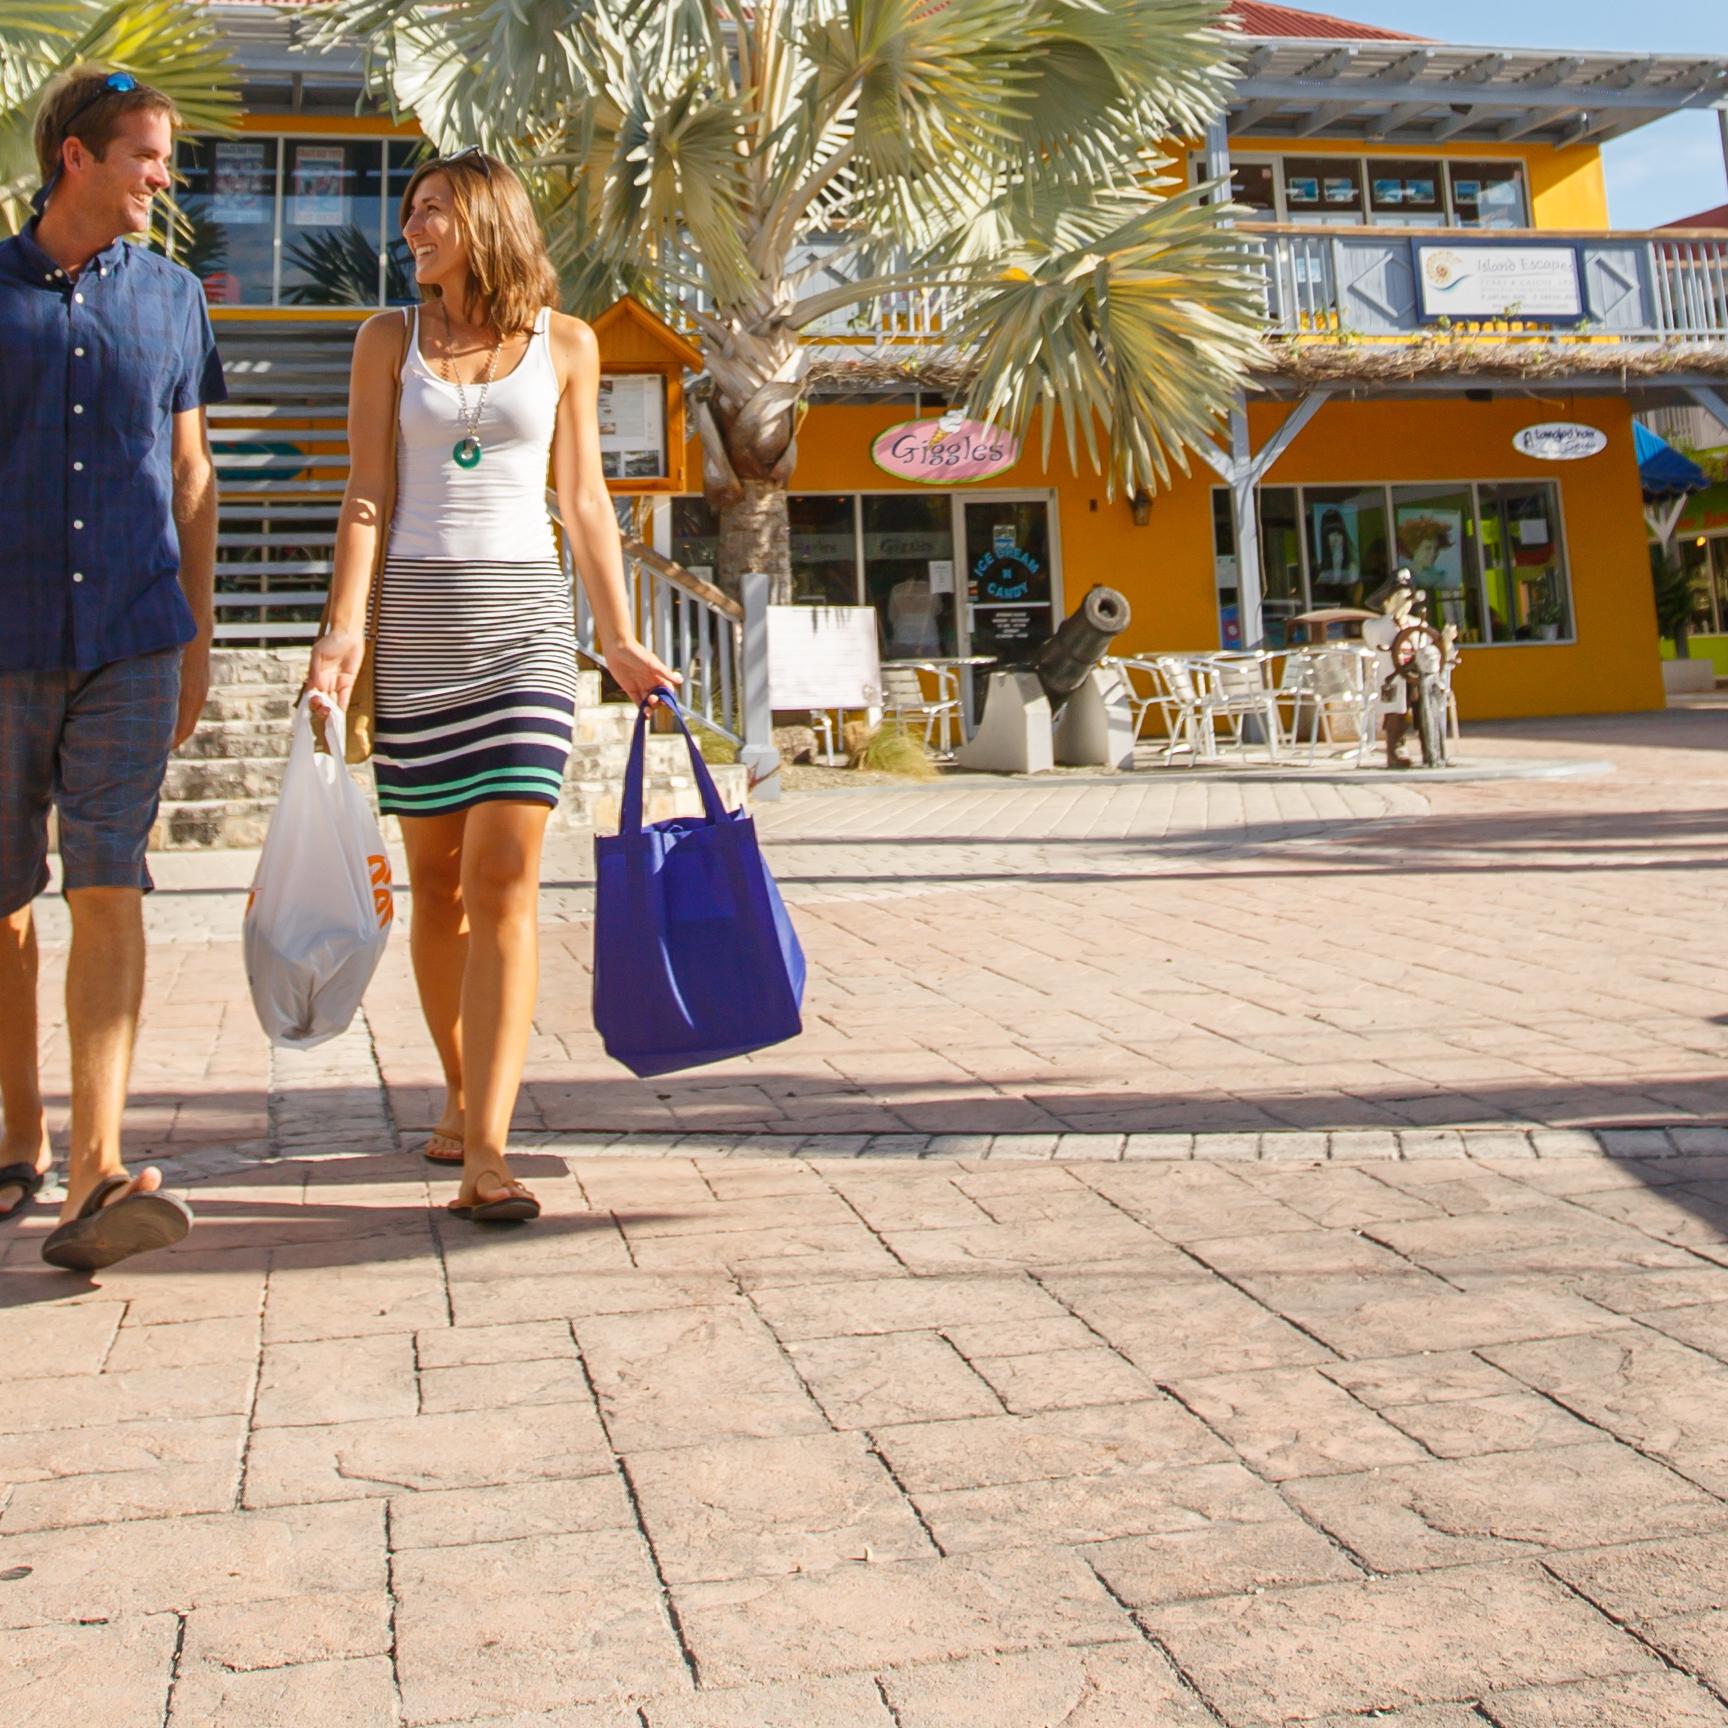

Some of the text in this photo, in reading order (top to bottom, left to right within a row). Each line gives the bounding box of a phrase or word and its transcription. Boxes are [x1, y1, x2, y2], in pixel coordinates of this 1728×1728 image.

[1478, 257, 1516, 273] Island
[891, 434, 1004, 466] Giggles
[974, 552, 995, 577] ICE
[987, 581, 1028, 600] CANDY
